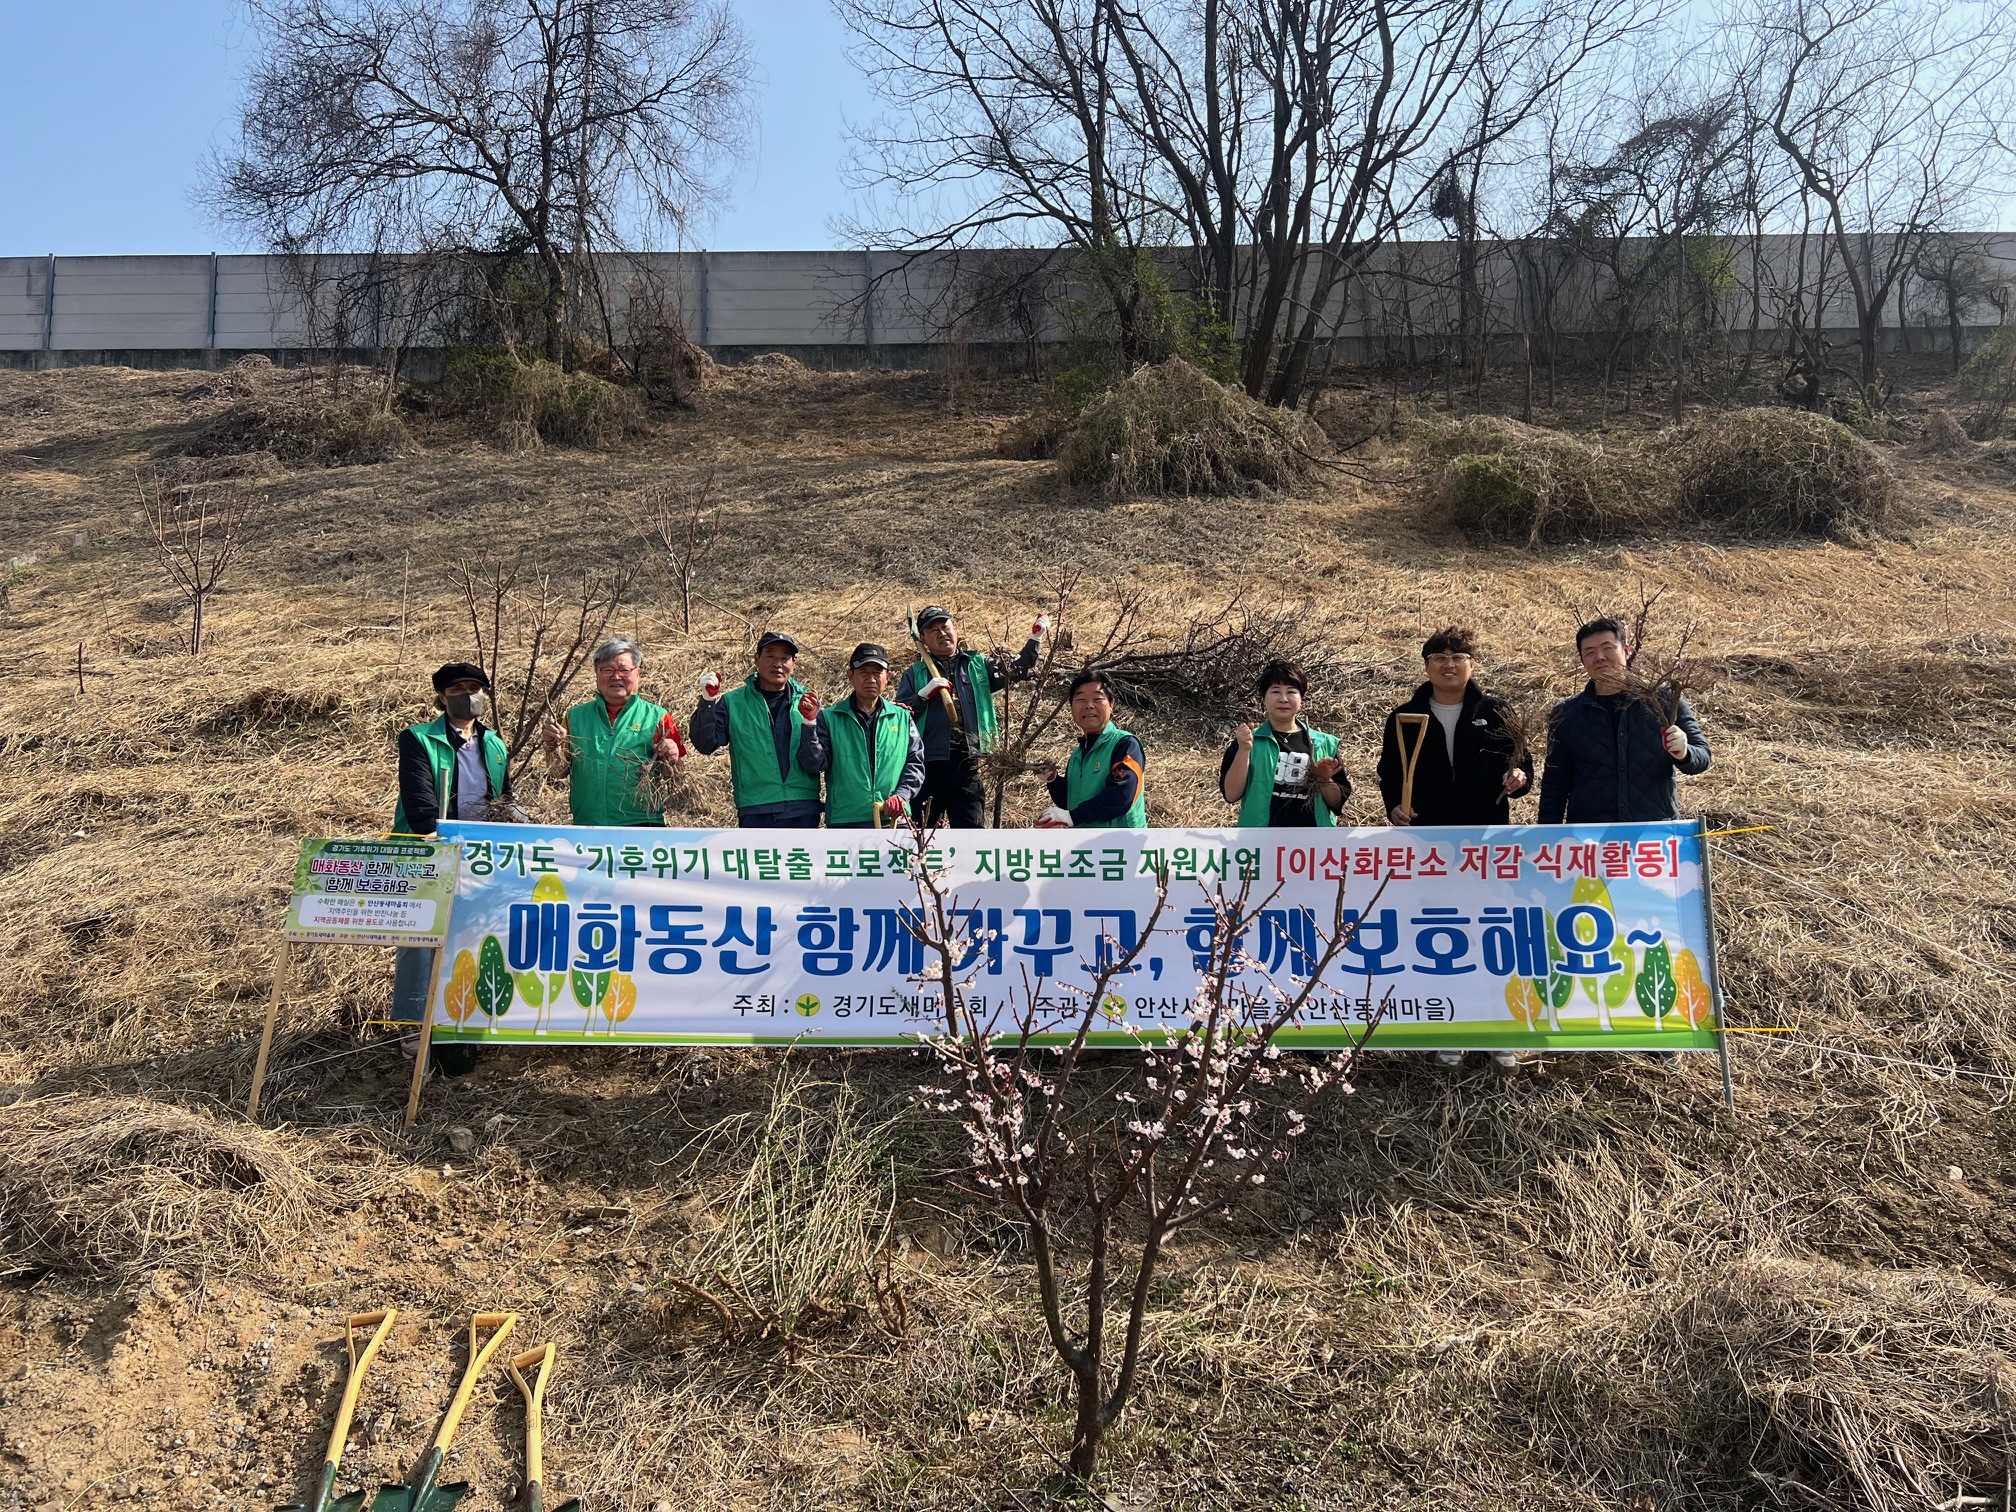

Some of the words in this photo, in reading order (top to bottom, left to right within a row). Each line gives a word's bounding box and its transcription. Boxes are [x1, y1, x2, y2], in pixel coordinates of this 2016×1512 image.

[332, 844, 351, 852] 경기도
[380, 846, 399, 854] 대탈출
[311, 859, 364, 874] 매화동산
[367, 861, 393, 875] 함께
[398, 862, 439, 878] 가꾸고,
[466, 842, 559, 876] 경기도
[576, 844, 709, 879] ‘기후위기
[722, 848, 814, 881] 대탈출
[974, 848, 1128, 882] 지방보조금
[1139, 847, 1261, 882] 지원사업
[1276, 846, 1448, 882] [이산화탄소
[1459, 844, 1524, 880] 저감
[1533, 839, 1679, 882] 식재활동]
[327, 877, 353, 890] 함께
[357, 878, 417, 893] 보호해요~
[317, 898, 336, 906] 수확한
[337, 899, 356, 907] 매실은
[368, 900, 408, 908] 안산동새마을회
[314, 916, 350, 925] 지역공동체를
[366, 918, 384, 926] 용도로
[328, 908, 358, 916] 지역주민을
[361, 909, 373, 917] 위한
[375, 910, 399, 918] 반찬나눔
[508, 903, 778, 975] 매화동산
[796, 906, 925, 976] 함께
[1341, 904, 1662, 976] 보호해요~
[833, 994, 988, 1018] 경기도새마회
